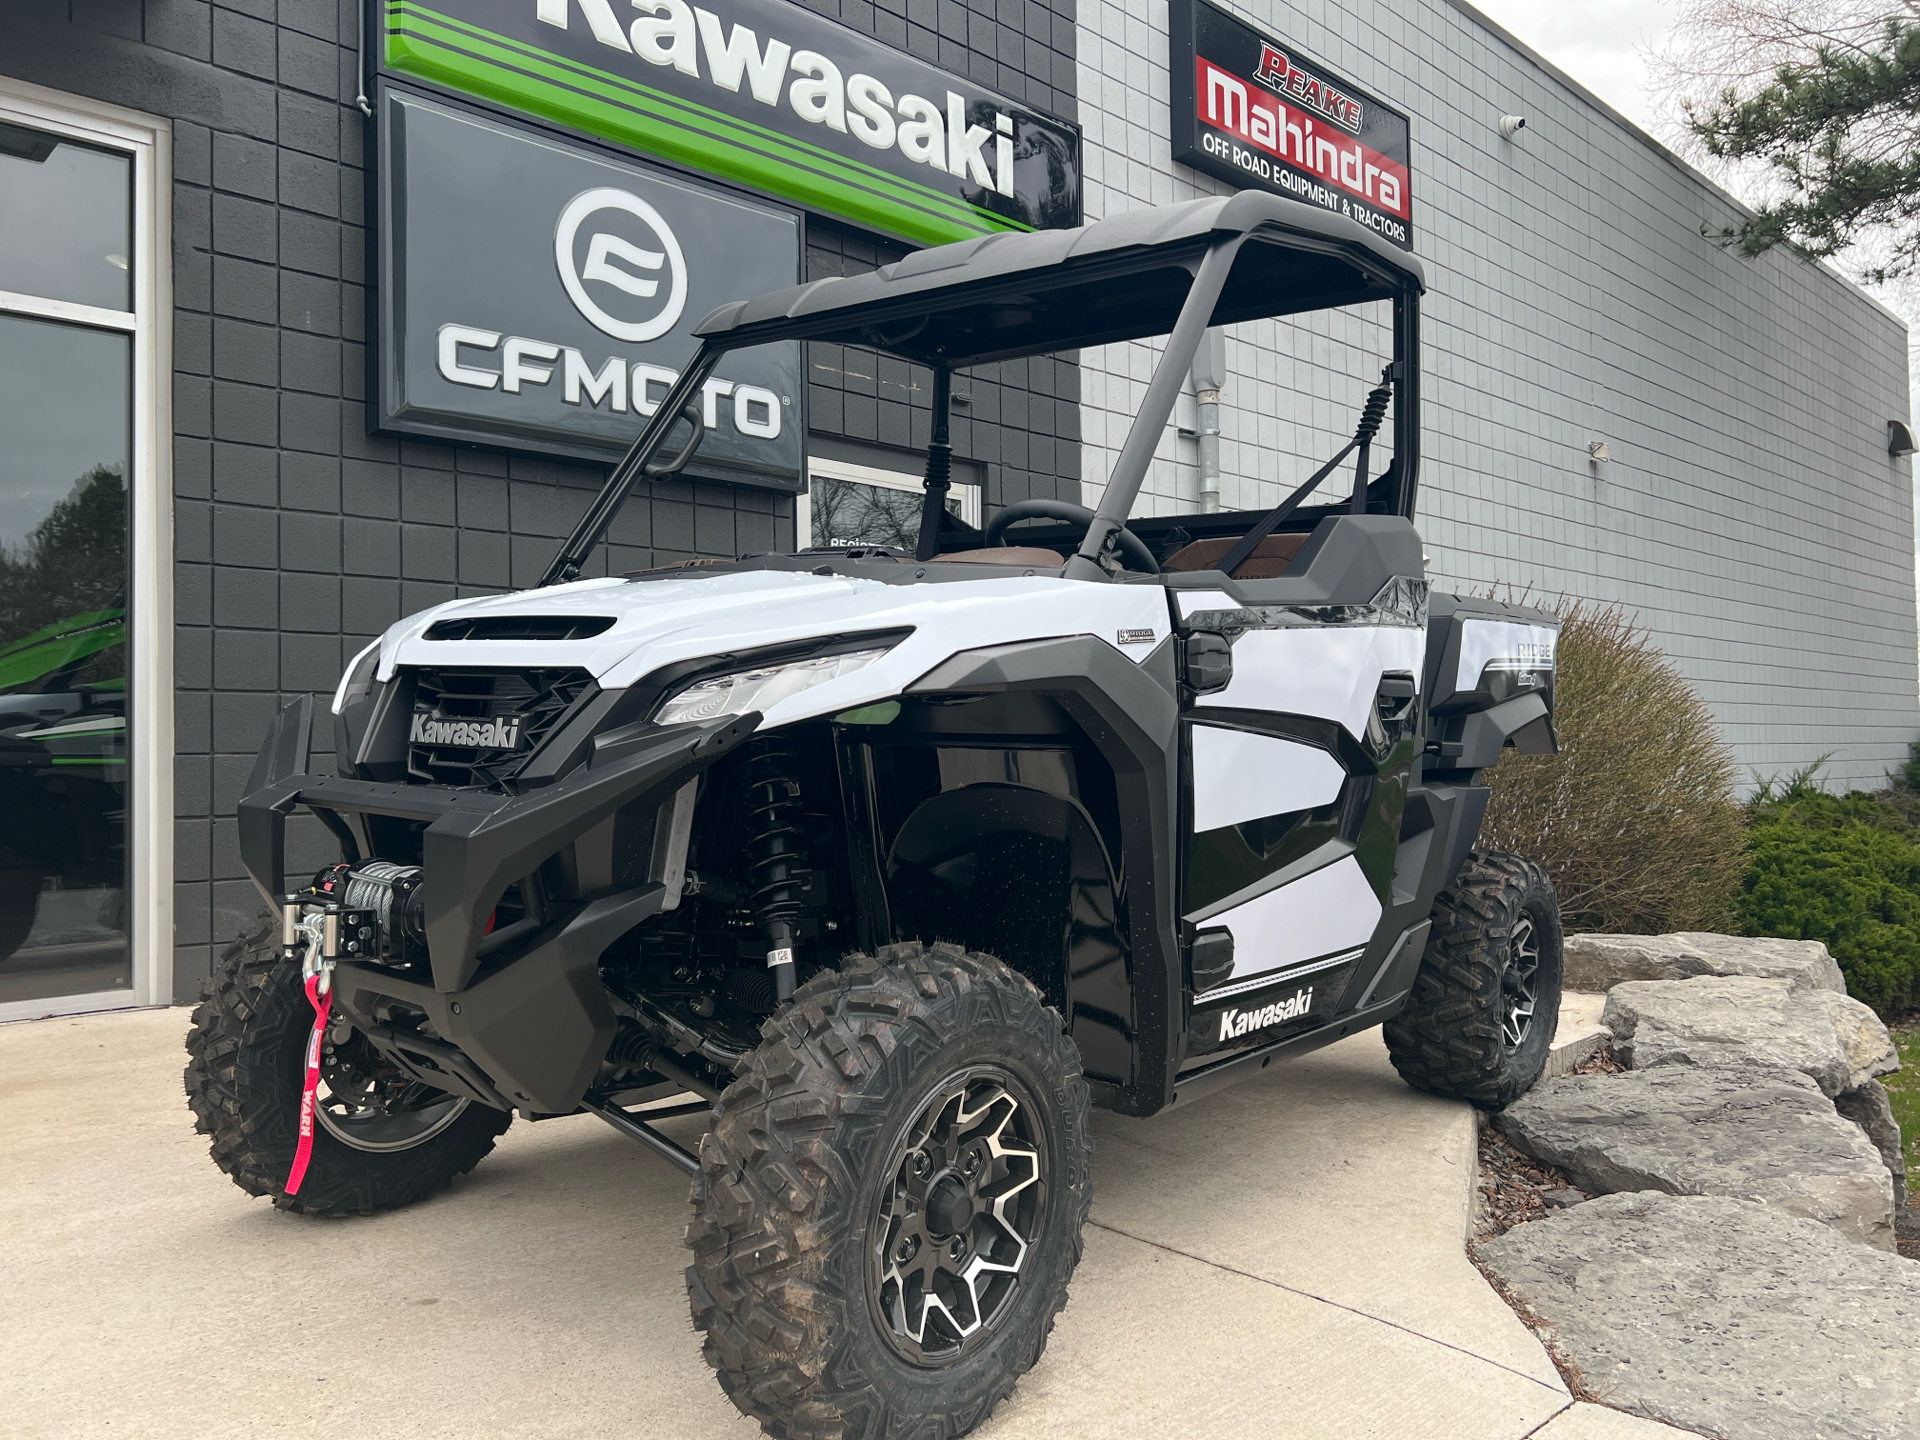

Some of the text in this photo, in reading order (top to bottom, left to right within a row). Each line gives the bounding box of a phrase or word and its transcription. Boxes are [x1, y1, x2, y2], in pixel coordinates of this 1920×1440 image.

[1254, 40, 1363, 134] PEAKE
[1202, 132, 1406, 243] OFF ROAD EQUIPMENT & TRACTORS
[1517, 643, 1551, 658] RIDGE
[409, 713, 520, 748] Kawasaki
[1218, 986, 1314, 1042] Kawasaki
[300, 1089, 314, 1137] WARN
[1053, 1087, 1078, 1189] DURO
